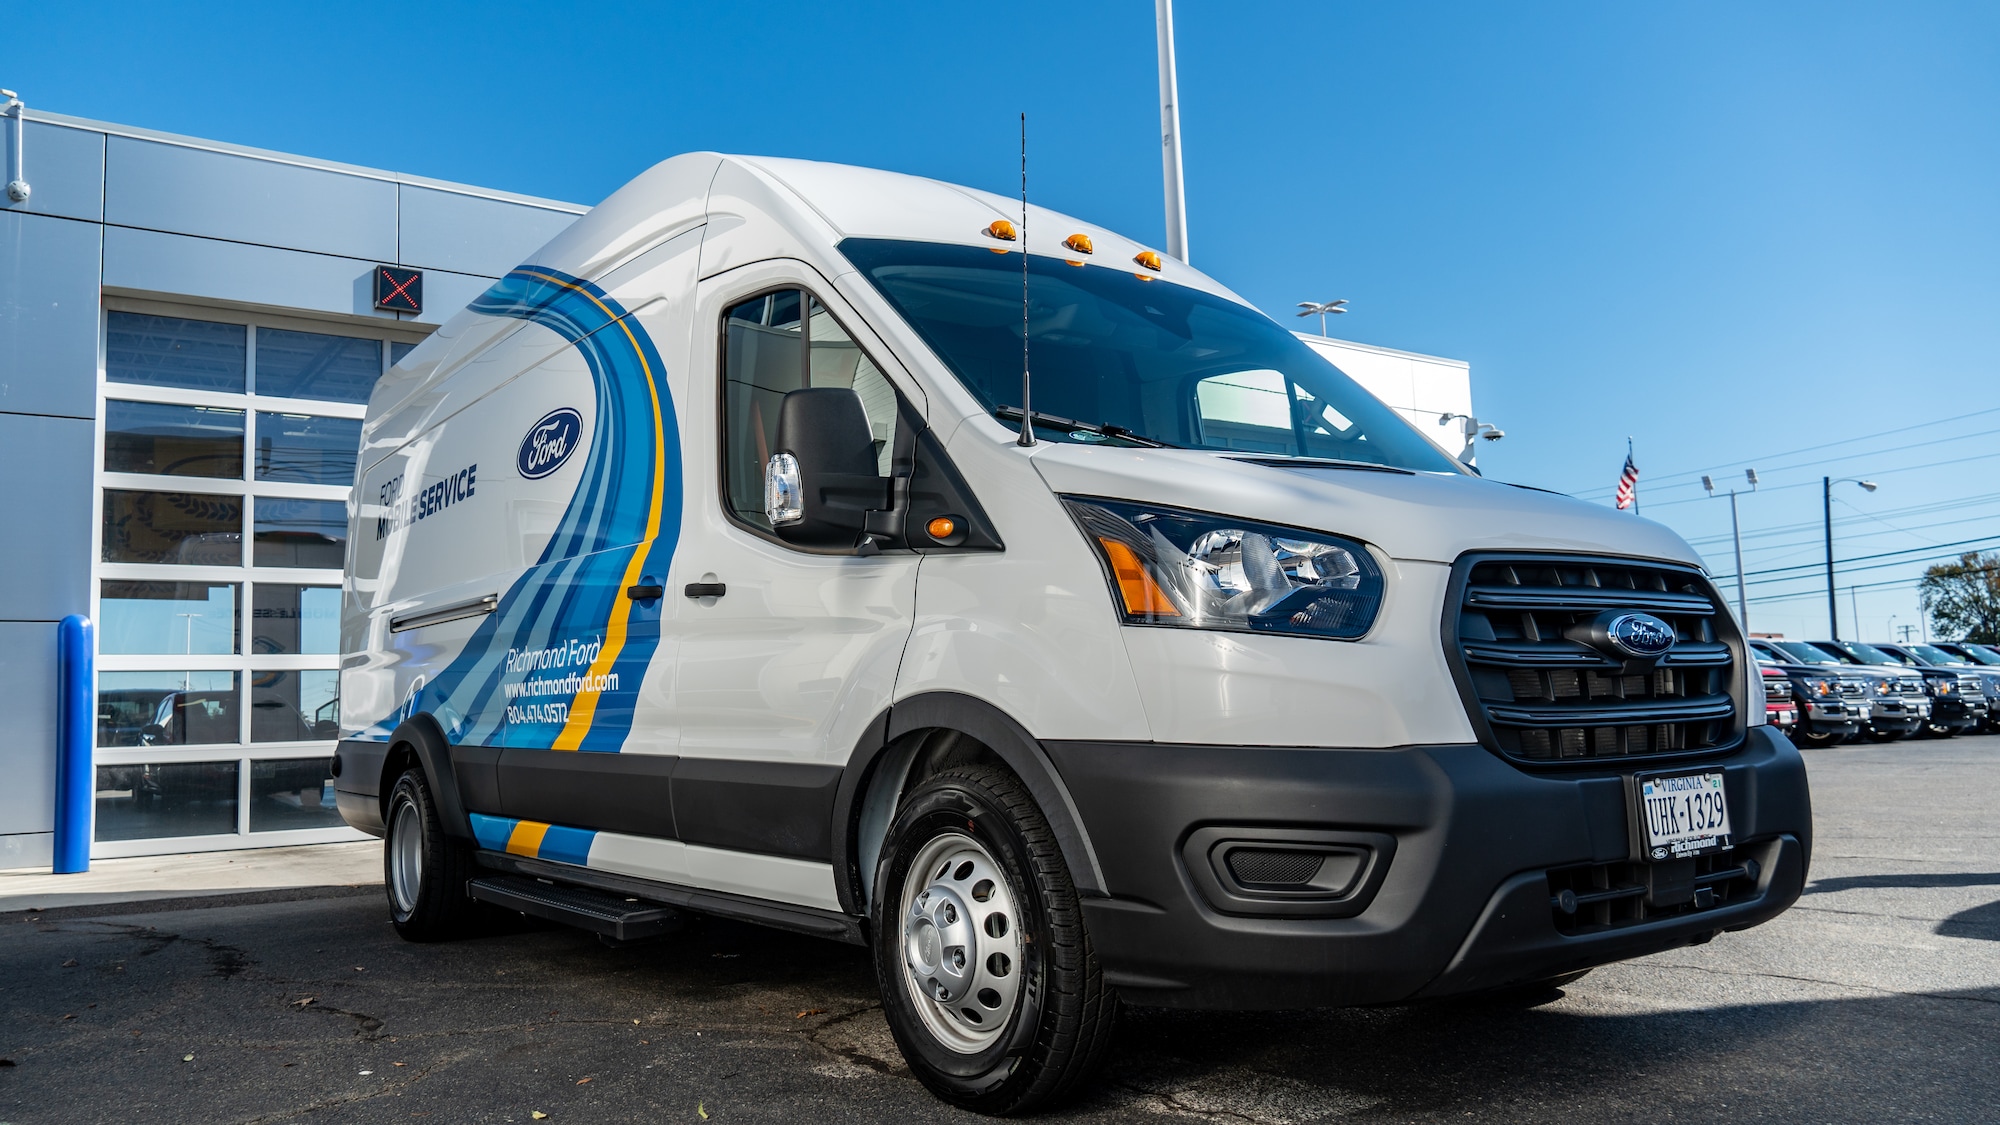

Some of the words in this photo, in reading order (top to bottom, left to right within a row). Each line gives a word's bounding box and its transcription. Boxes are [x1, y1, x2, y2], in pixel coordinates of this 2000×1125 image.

[528, 420, 569, 470] Ford
[376, 495, 418, 541] MOBILE
[418, 464, 477, 520] SERVICE
[380, 474, 404, 507] FORD
[1631, 620, 1666, 645] Ford
[506, 640, 567, 673] Richmond
[567, 634, 600, 667] Ford
[504, 671, 619, 698] www.richmondford.com
[506, 702, 570, 724] 804.474.0572
[1661, 776, 1703, 792] VIRGINIA
[1712, 780, 1721, 788] 21
[1671, 836, 1717, 853] Richmond
